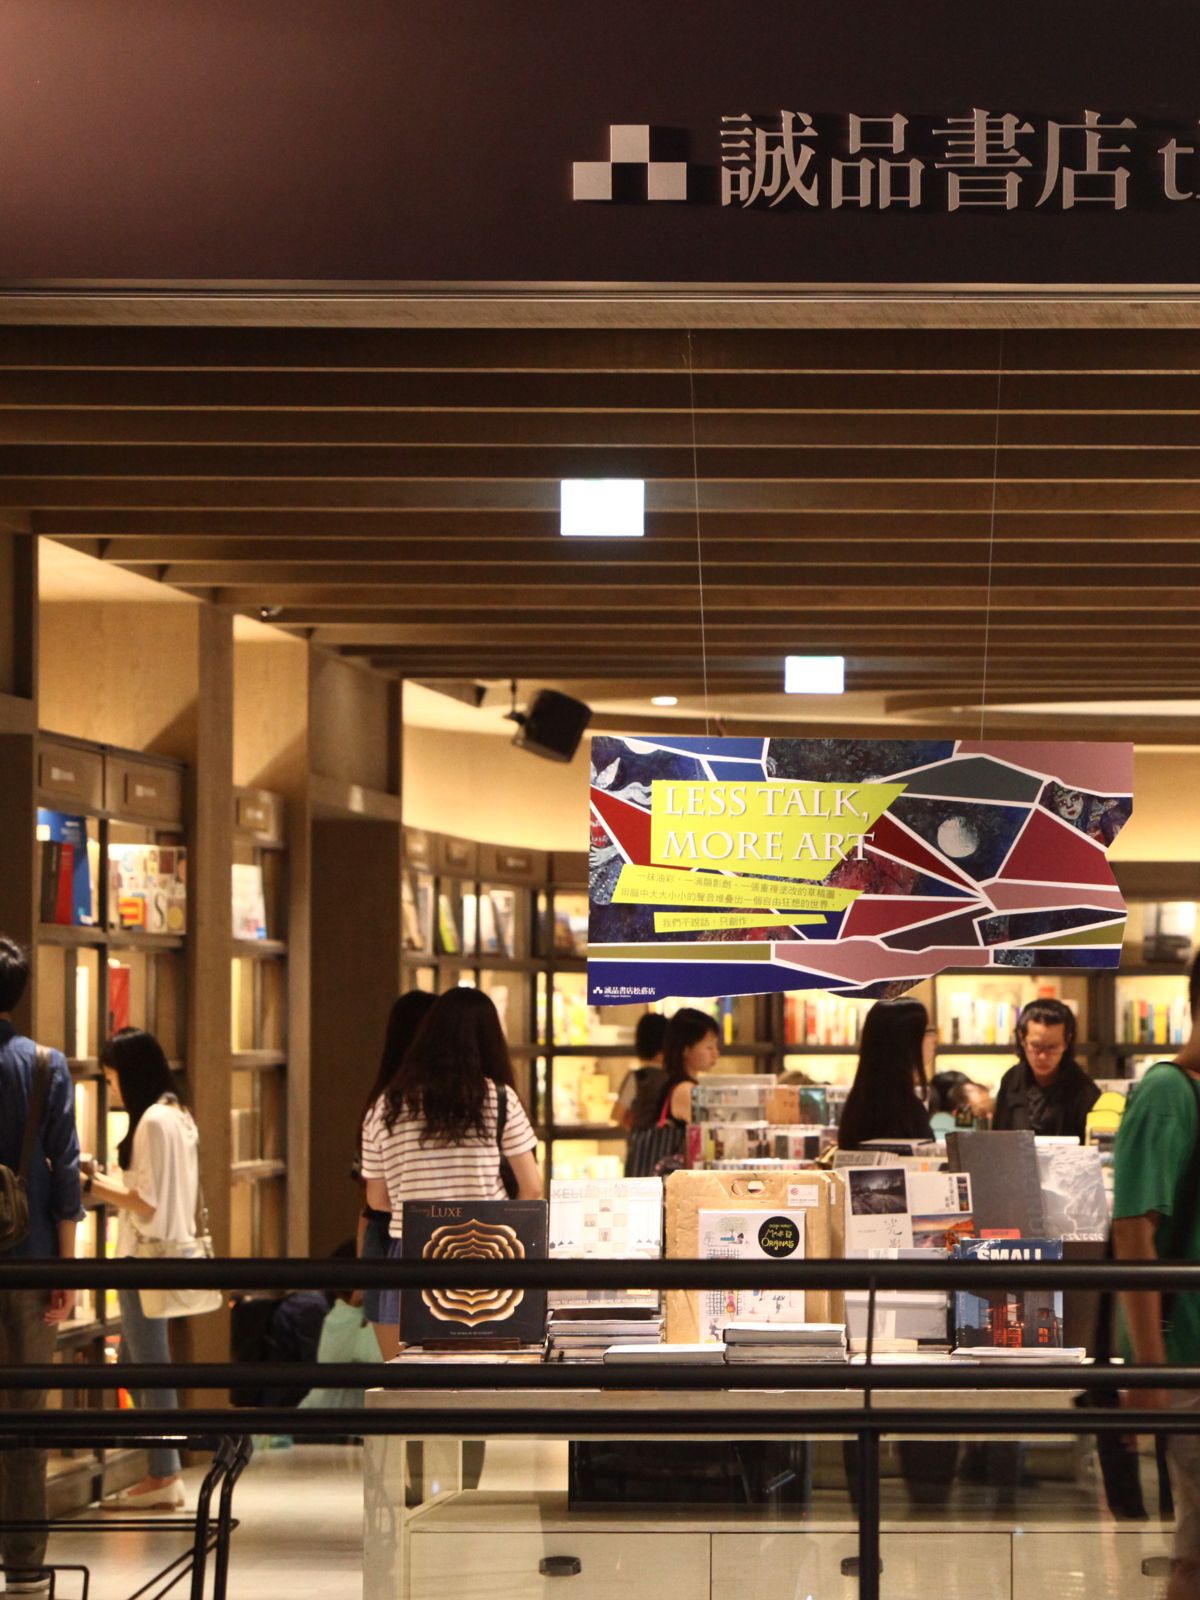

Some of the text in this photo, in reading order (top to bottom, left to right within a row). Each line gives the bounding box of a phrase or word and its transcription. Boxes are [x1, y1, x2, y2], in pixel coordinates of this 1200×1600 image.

[720, 108, 1137, 211] 誠品書店
[664, 786, 870, 822] LESS TALK,
[661, 830, 876, 862] MORE ART
